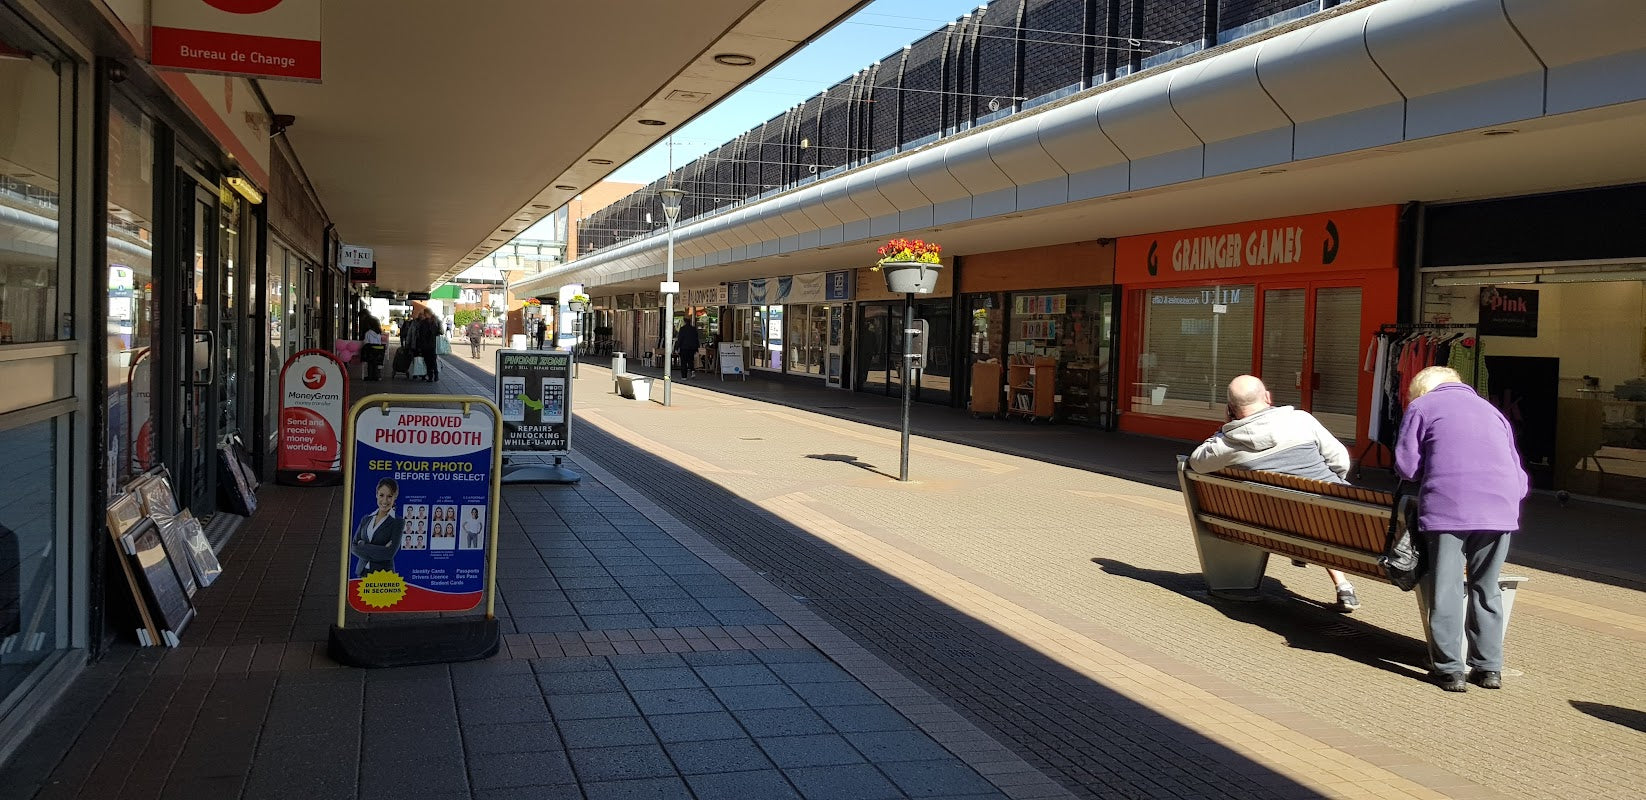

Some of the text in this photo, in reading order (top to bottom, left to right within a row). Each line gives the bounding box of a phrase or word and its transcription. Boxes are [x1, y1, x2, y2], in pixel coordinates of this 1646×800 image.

[180, 45, 296, 68] Bureau de Change
[1172, 226, 1303, 272] GRAINGER GAMES
[1490, 295, 1528, 313] Pink
[505, 356, 567, 366] PHONE ZONE
[289, 391, 339, 402] MoneyGram
[287, 417, 324, 426] Send and
[398, 415, 462, 428] APPROVED
[287, 436, 314, 444] money
[375, 429, 482, 446] PHOTO BOOTH
[286, 444, 327, 452] worldwide
[369, 460, 473, 472] SEE YOUR PHOTO
[395, 472, 486, 482] BEFORE YOU SELECT
